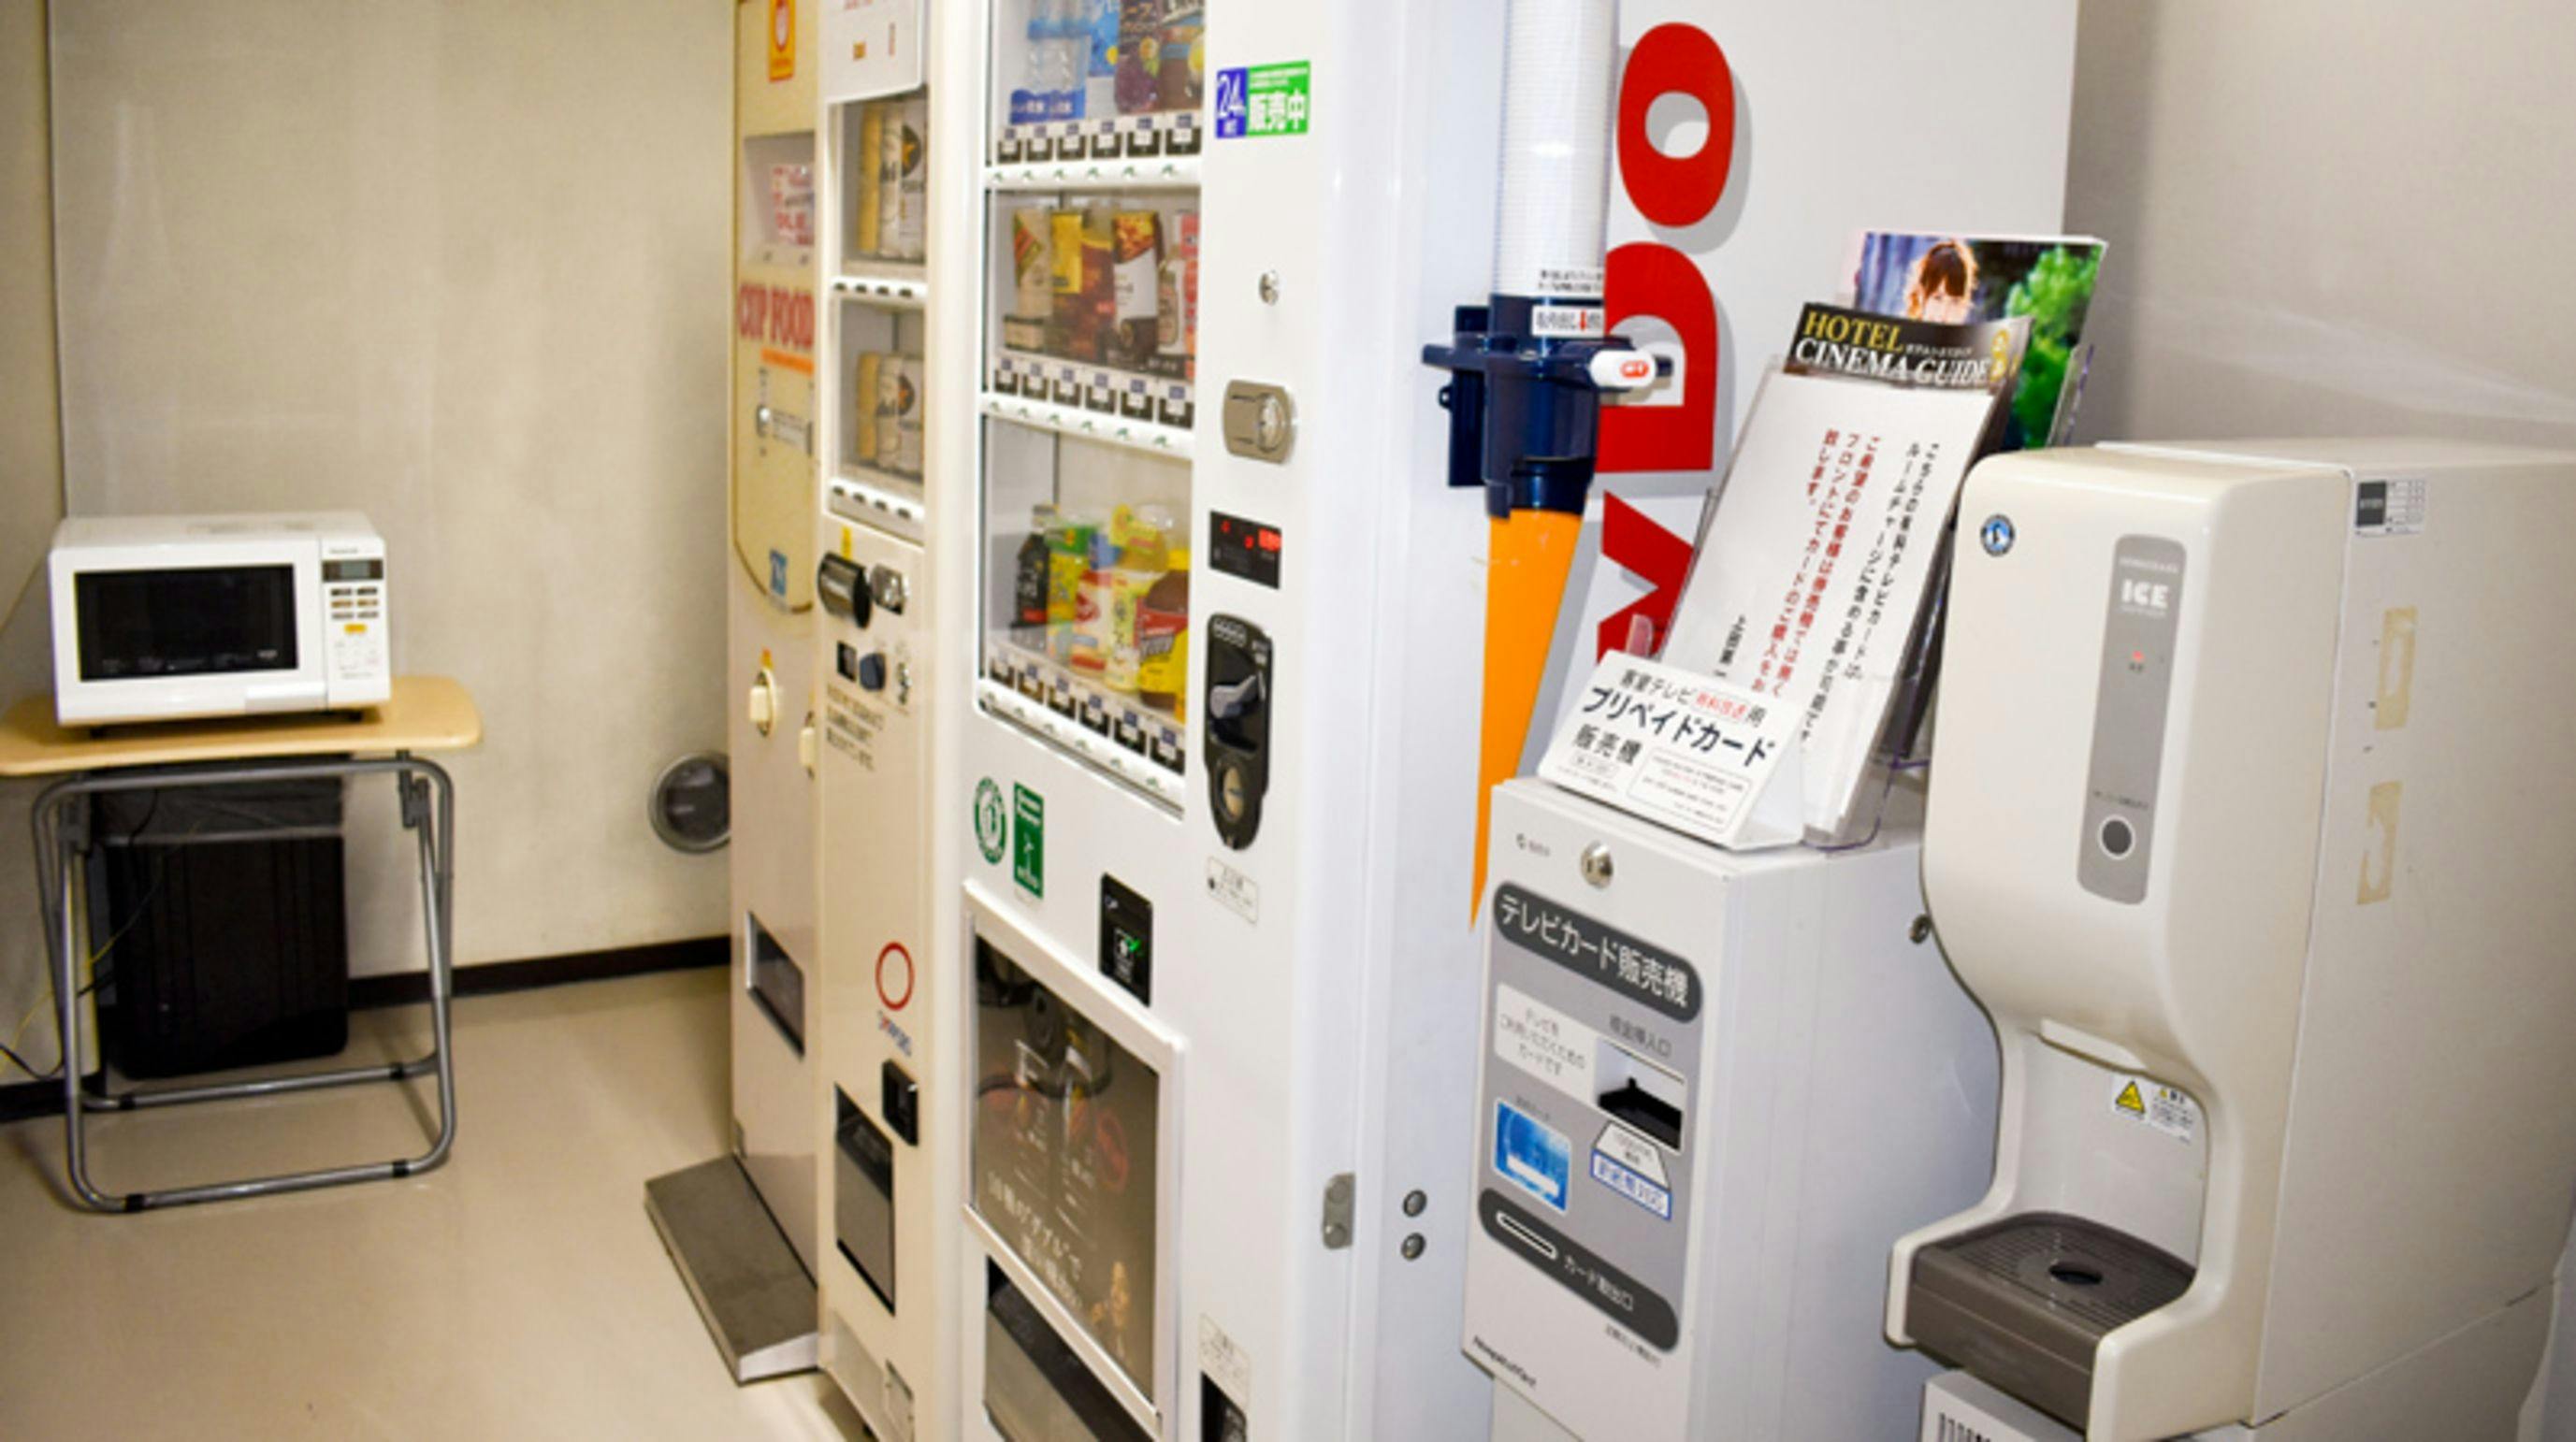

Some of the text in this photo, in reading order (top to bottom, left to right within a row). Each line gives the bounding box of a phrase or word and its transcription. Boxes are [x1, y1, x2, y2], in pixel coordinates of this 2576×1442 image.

[1249, 89, 1308, 131] 販売中
[1803, 310, 1905, 353] HOTEL
[1794, 337, 1909, 382] CINEMA
[1913, 357, 1991, 386] GUIDE
[2120, 579, 2171, 608] ICE
[1574, 723, 1643, 767] 販売機
[1498, 893, 1689, 1009] テレビカード販売機
